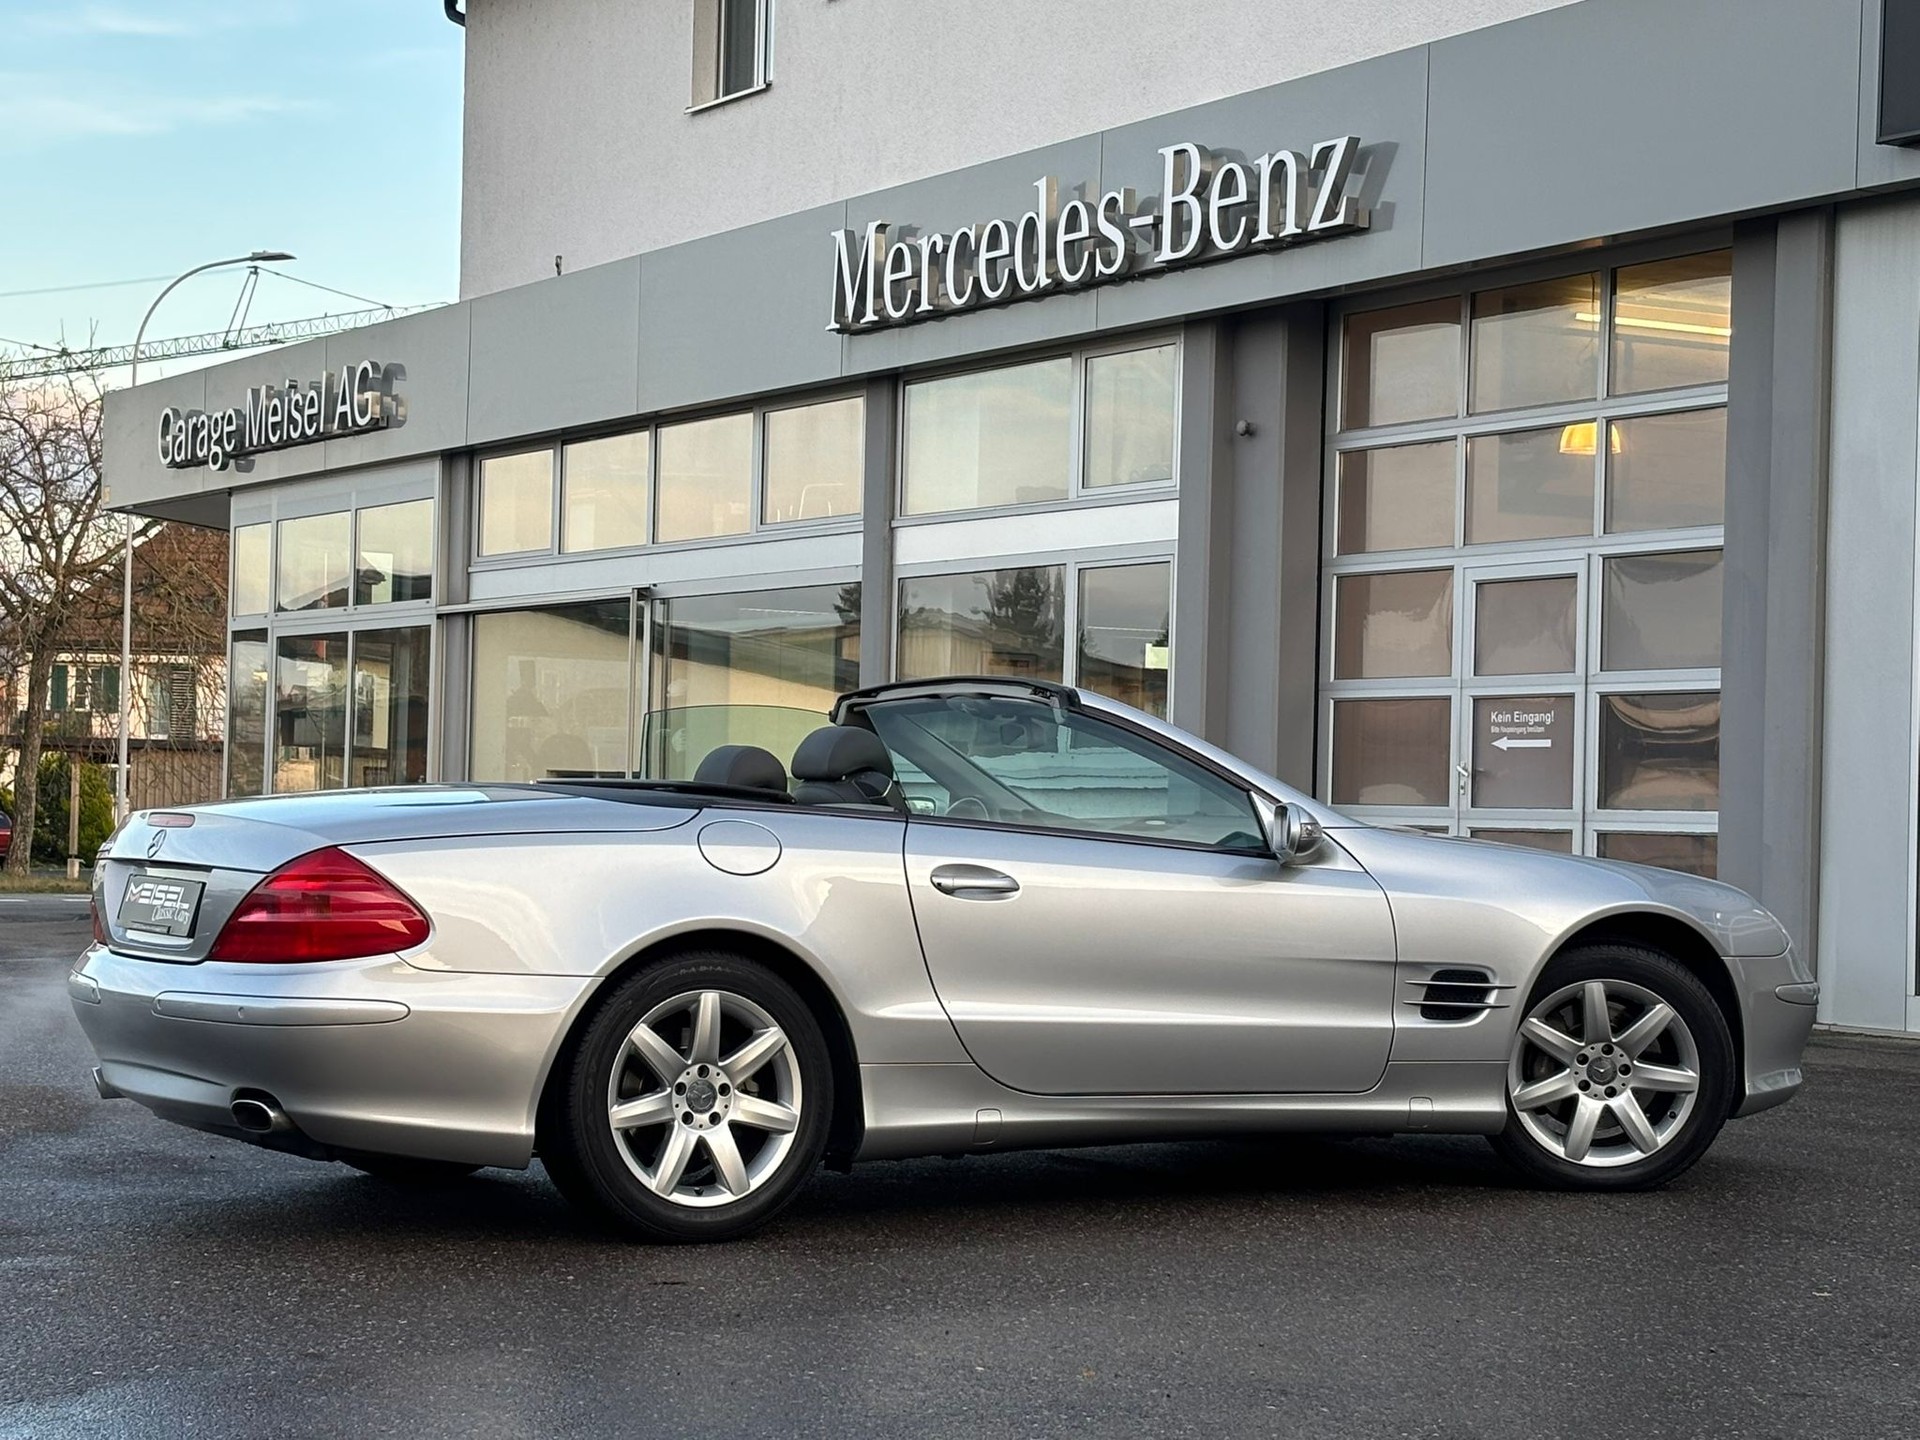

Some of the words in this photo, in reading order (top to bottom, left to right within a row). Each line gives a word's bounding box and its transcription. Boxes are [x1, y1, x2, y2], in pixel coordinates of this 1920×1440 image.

[825, 135, 1365, 333] Mercedes-Benz
[157, 406, 238, 472] Garage
[245, 370, 328, 449] Meisel
[334, 359, 376, 431] AG
[1490, 711, 1511, 723] Kein
[1513, 709, 1555, 726] Eingang!
[125, 882, 190, 910] MEISEL
